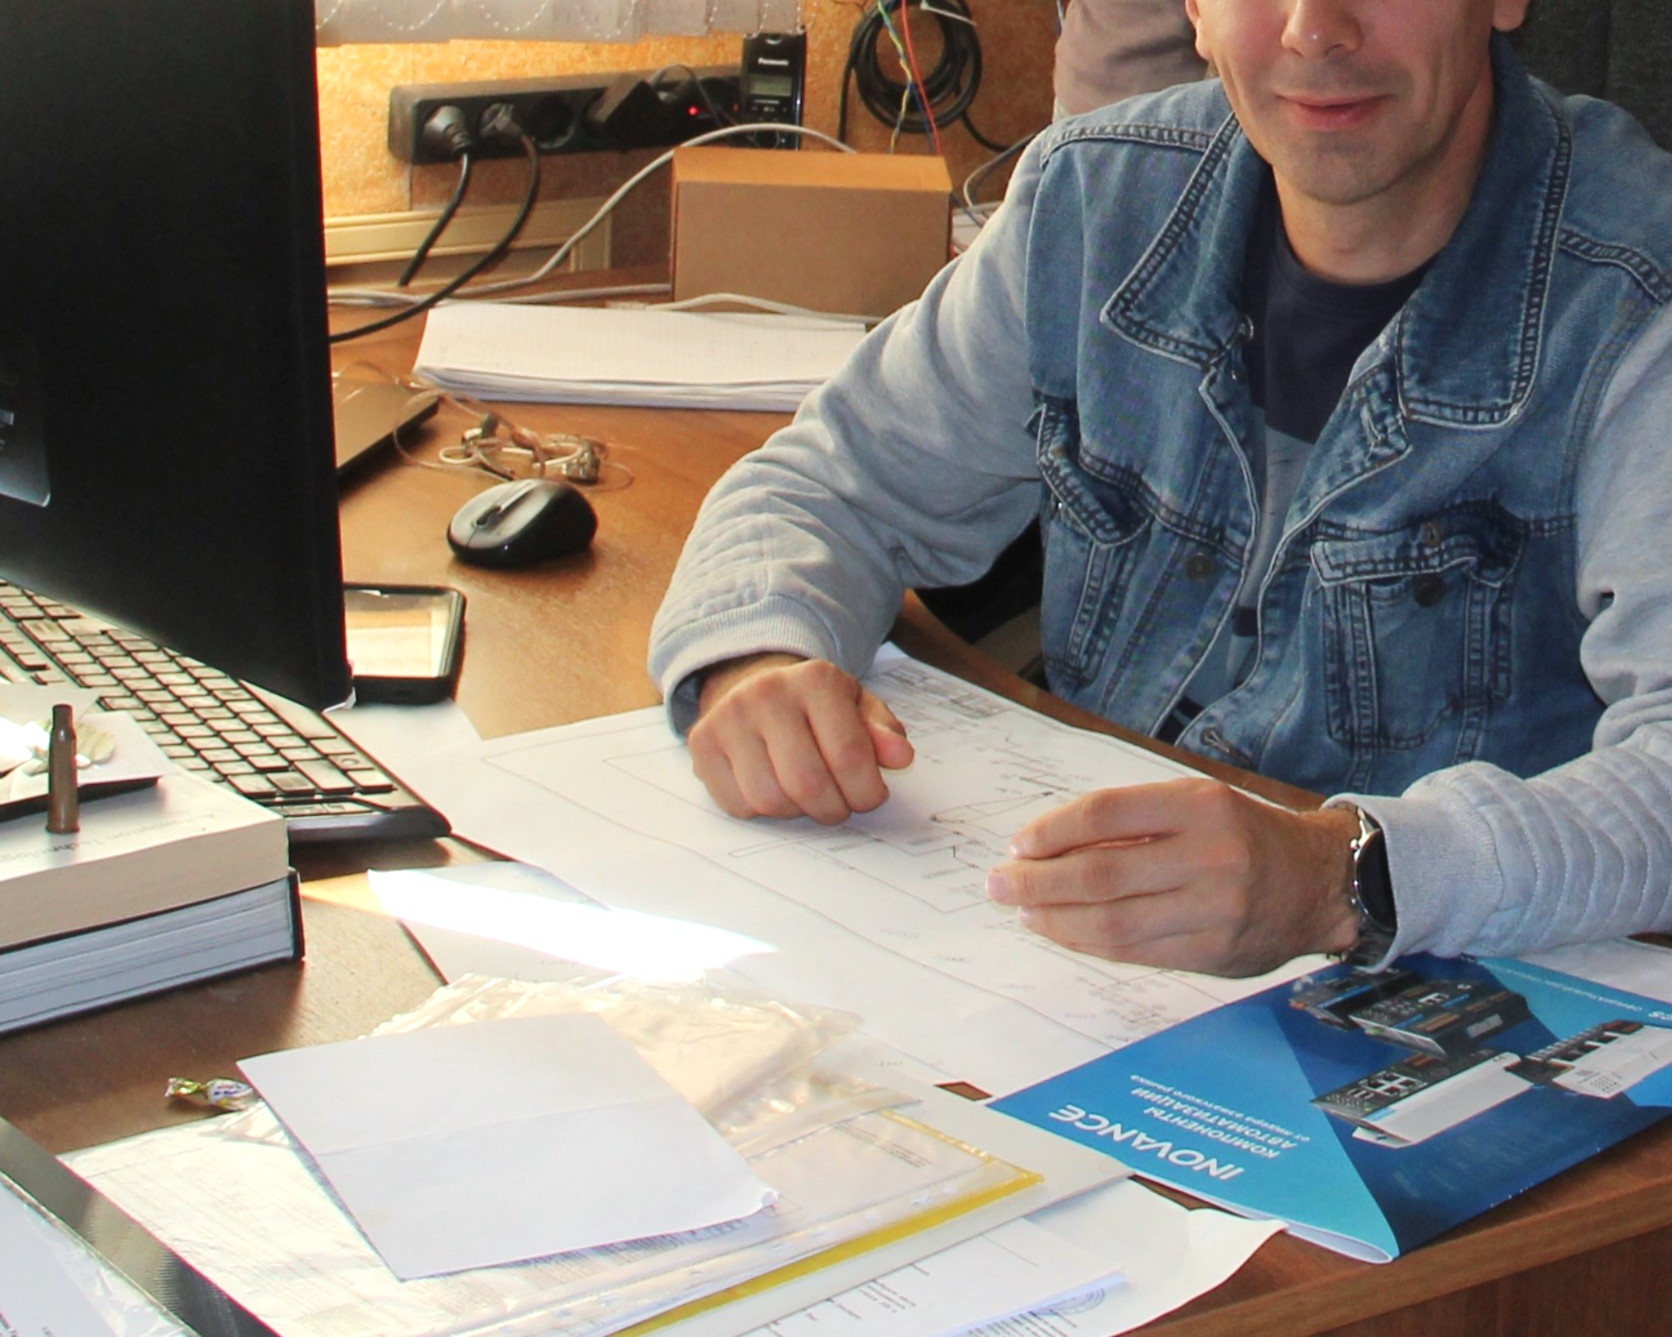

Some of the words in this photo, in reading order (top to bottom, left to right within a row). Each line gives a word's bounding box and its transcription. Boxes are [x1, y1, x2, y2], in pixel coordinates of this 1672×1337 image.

[1130, 1074, 1174, 1094] рынка
[1172, 1089, 1242, 1120] азиатского
[1130, 1087, 1299, 1150] АВТОМАТИЗАЦИИ
[1143, 1106, 1281, 1160] КОМПОНЕНТЫ
[1243, 1113, 1294, 1137] лидера
[1048, 1104, 1246, 1181] INOVANCE
